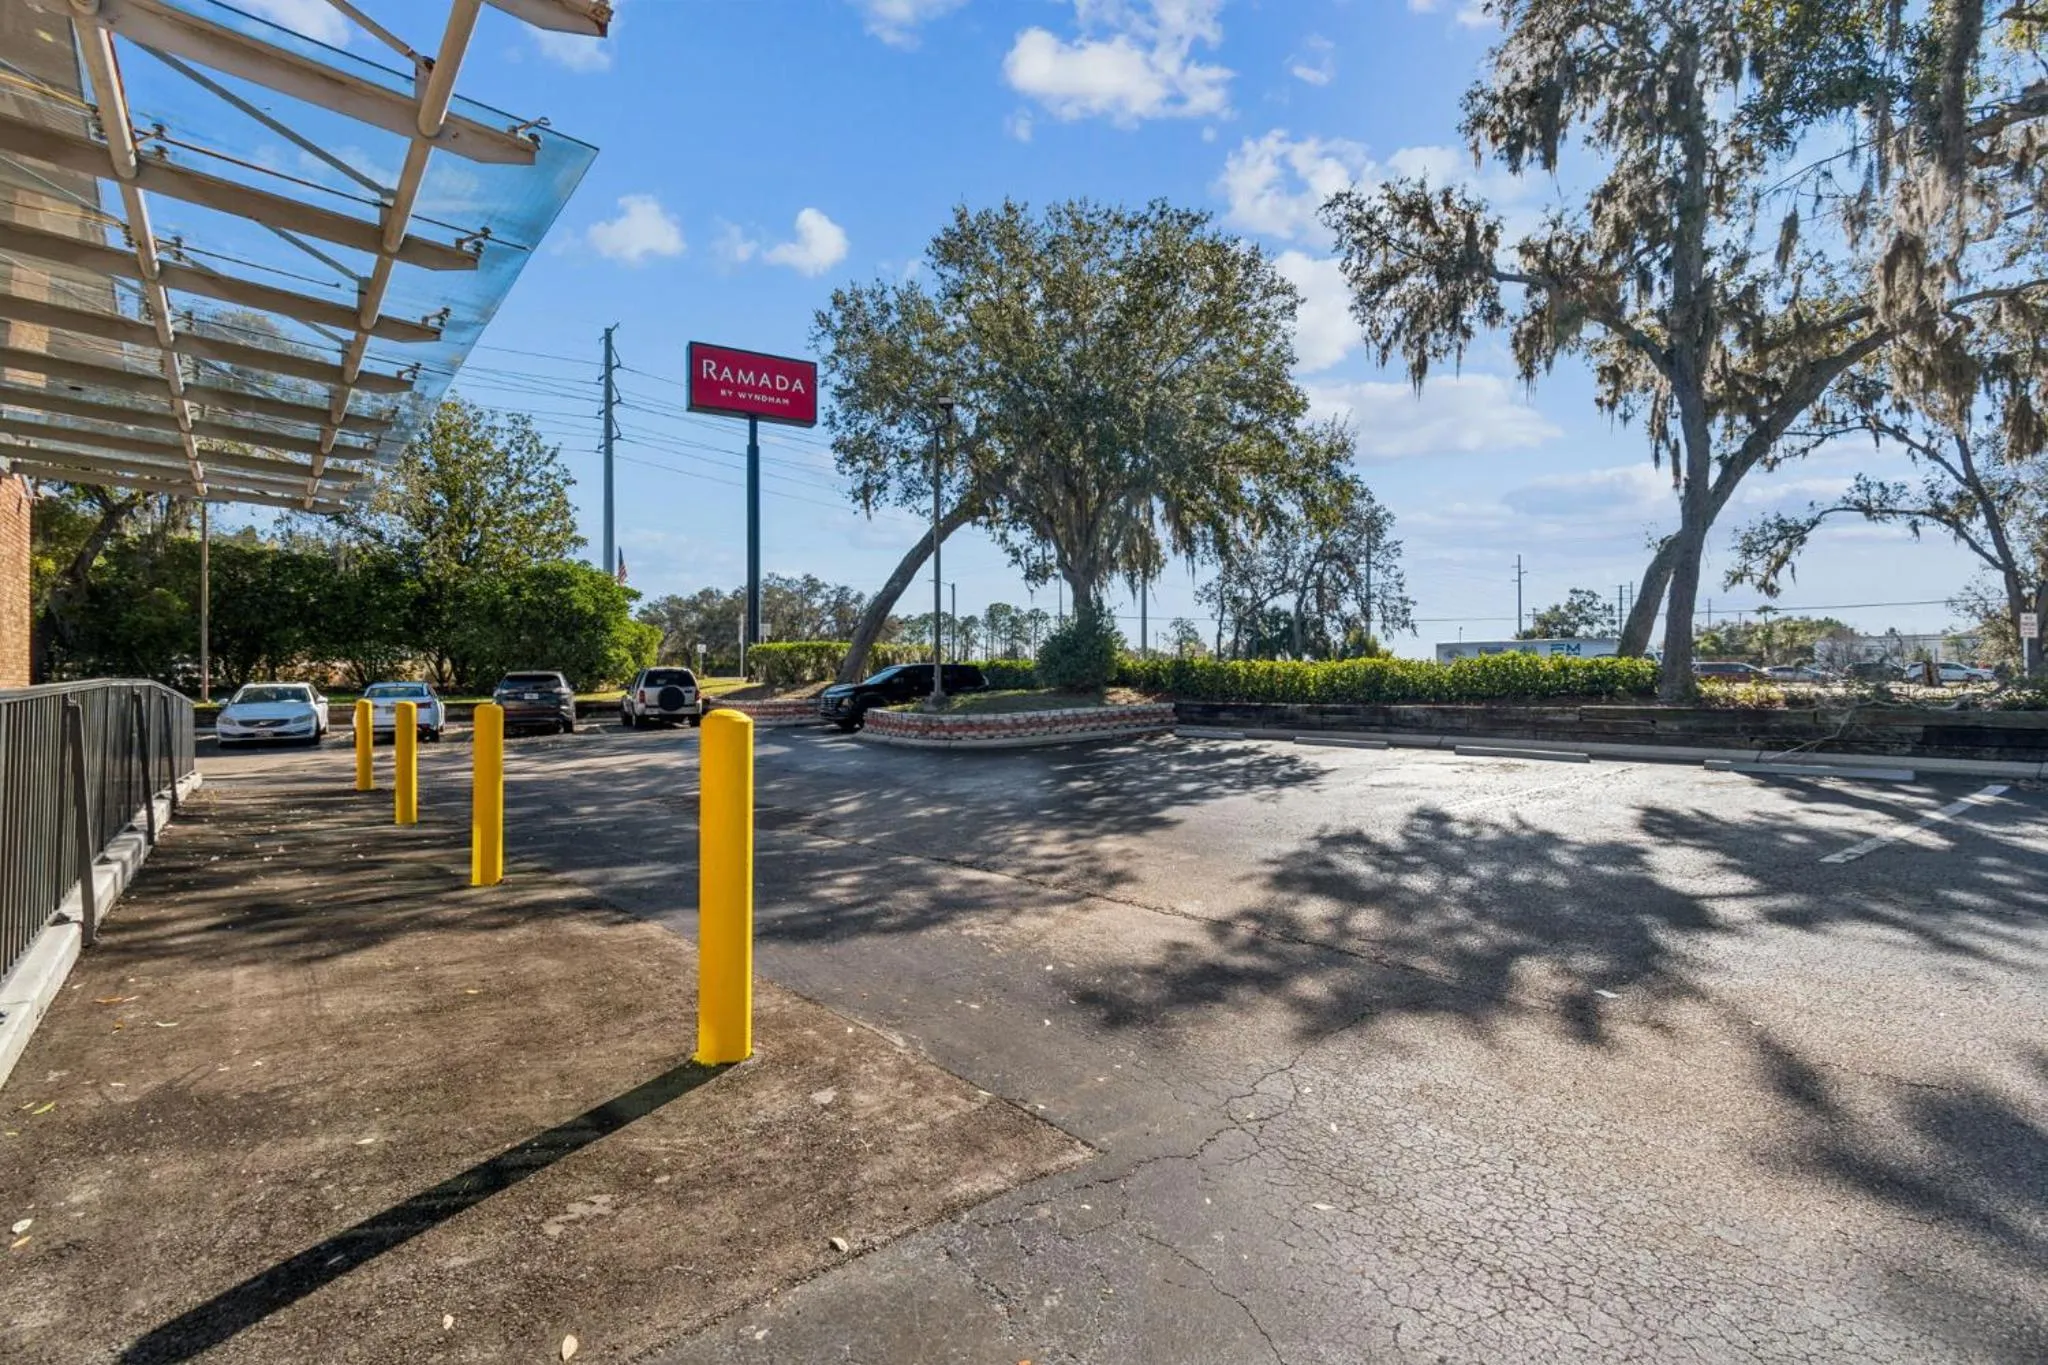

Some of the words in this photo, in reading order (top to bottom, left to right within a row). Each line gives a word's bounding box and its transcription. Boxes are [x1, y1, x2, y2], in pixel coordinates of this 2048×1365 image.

[702, 359, 805, 394] RAMADA
[720, 388, 733, 397] BY
[737, 391, 790, 405] WYNDHAM
